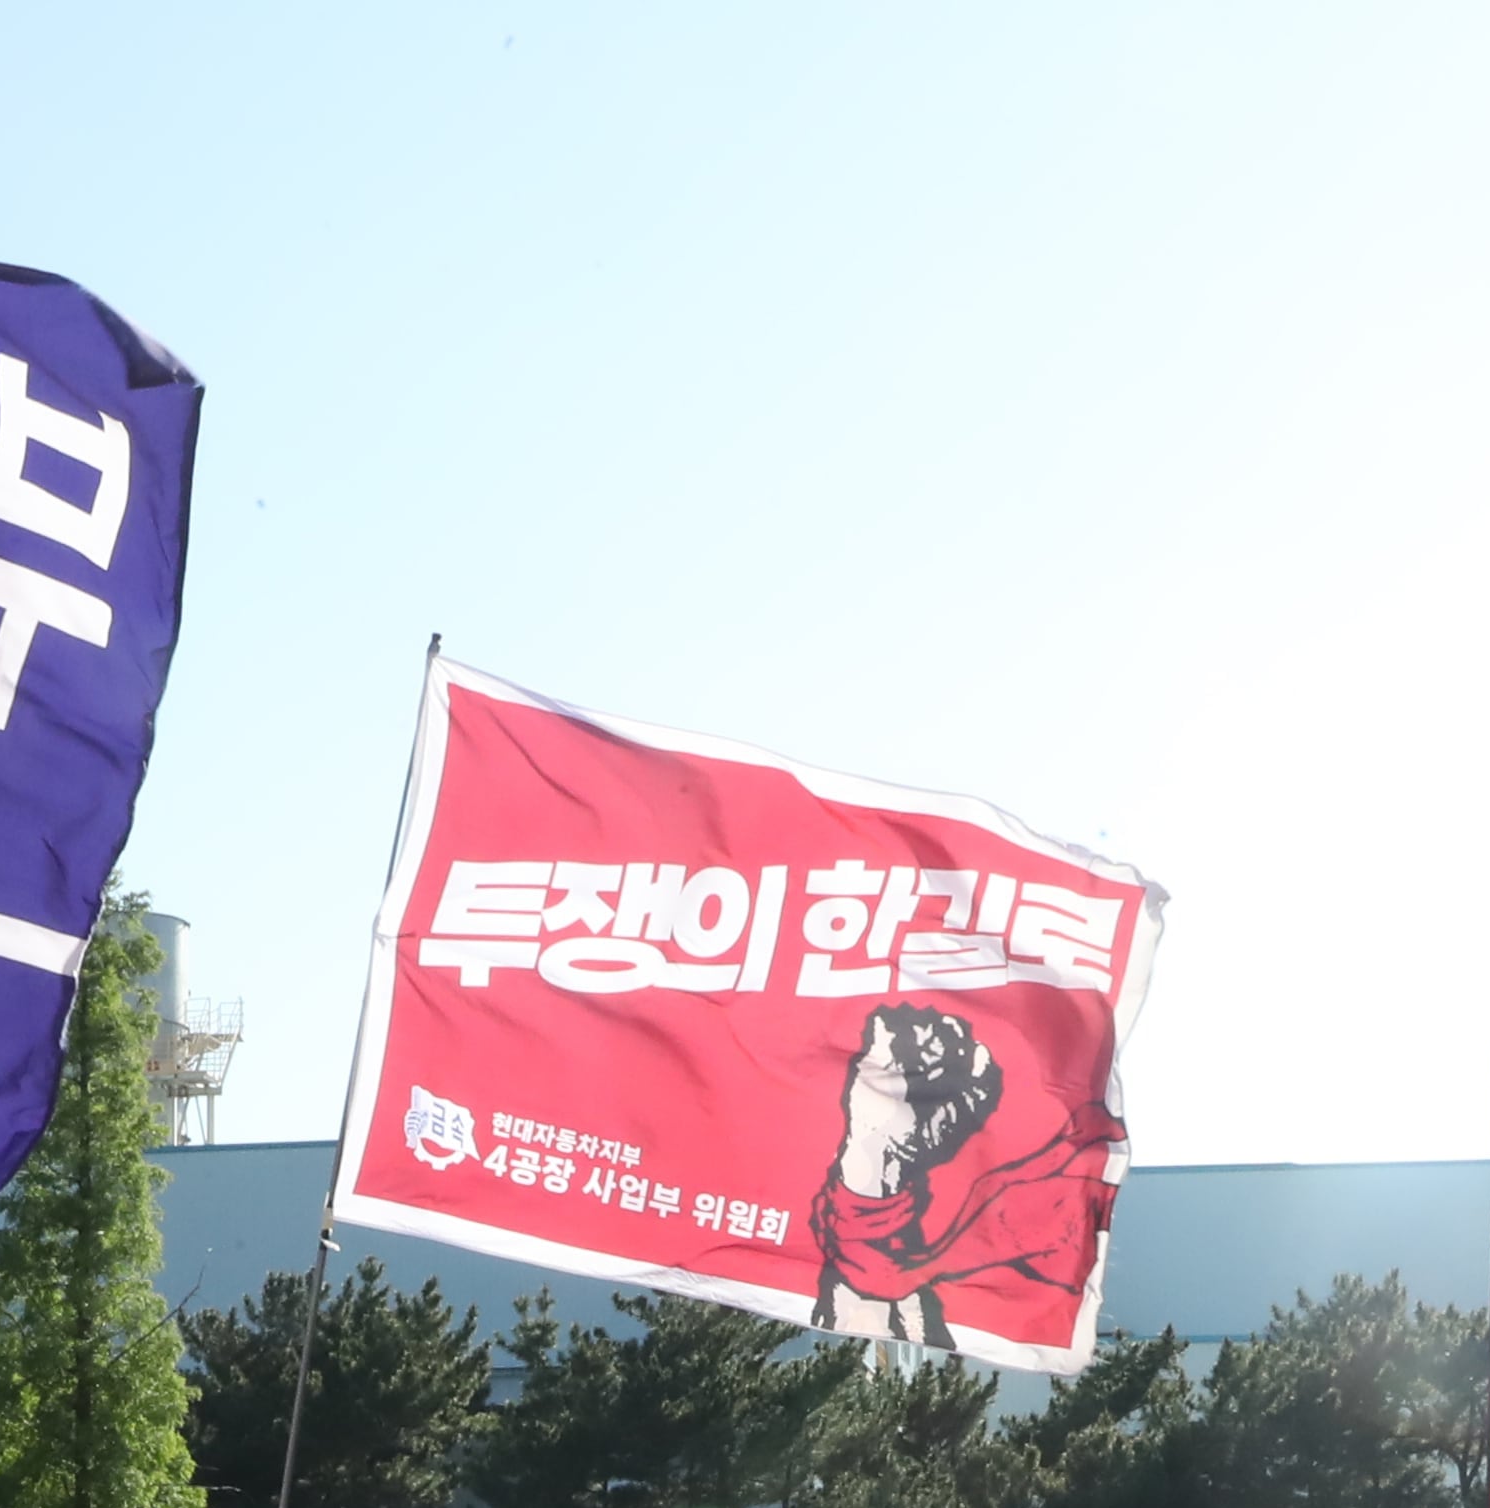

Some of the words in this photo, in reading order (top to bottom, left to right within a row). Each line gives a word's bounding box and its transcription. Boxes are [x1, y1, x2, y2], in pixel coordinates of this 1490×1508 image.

[419, 860, 787, 993] 투쟁의
[796, 859, 1126, 998] 한길로
[430, 1100, 465, 1150] 금속
[491, 1112, 642, 1168] 현대자동차지부
[482, 1145, 576, 1194] 4공장
[582, 1167, 680, 1218] 사업부
[691, 1193, 791, 1246] 위원회
